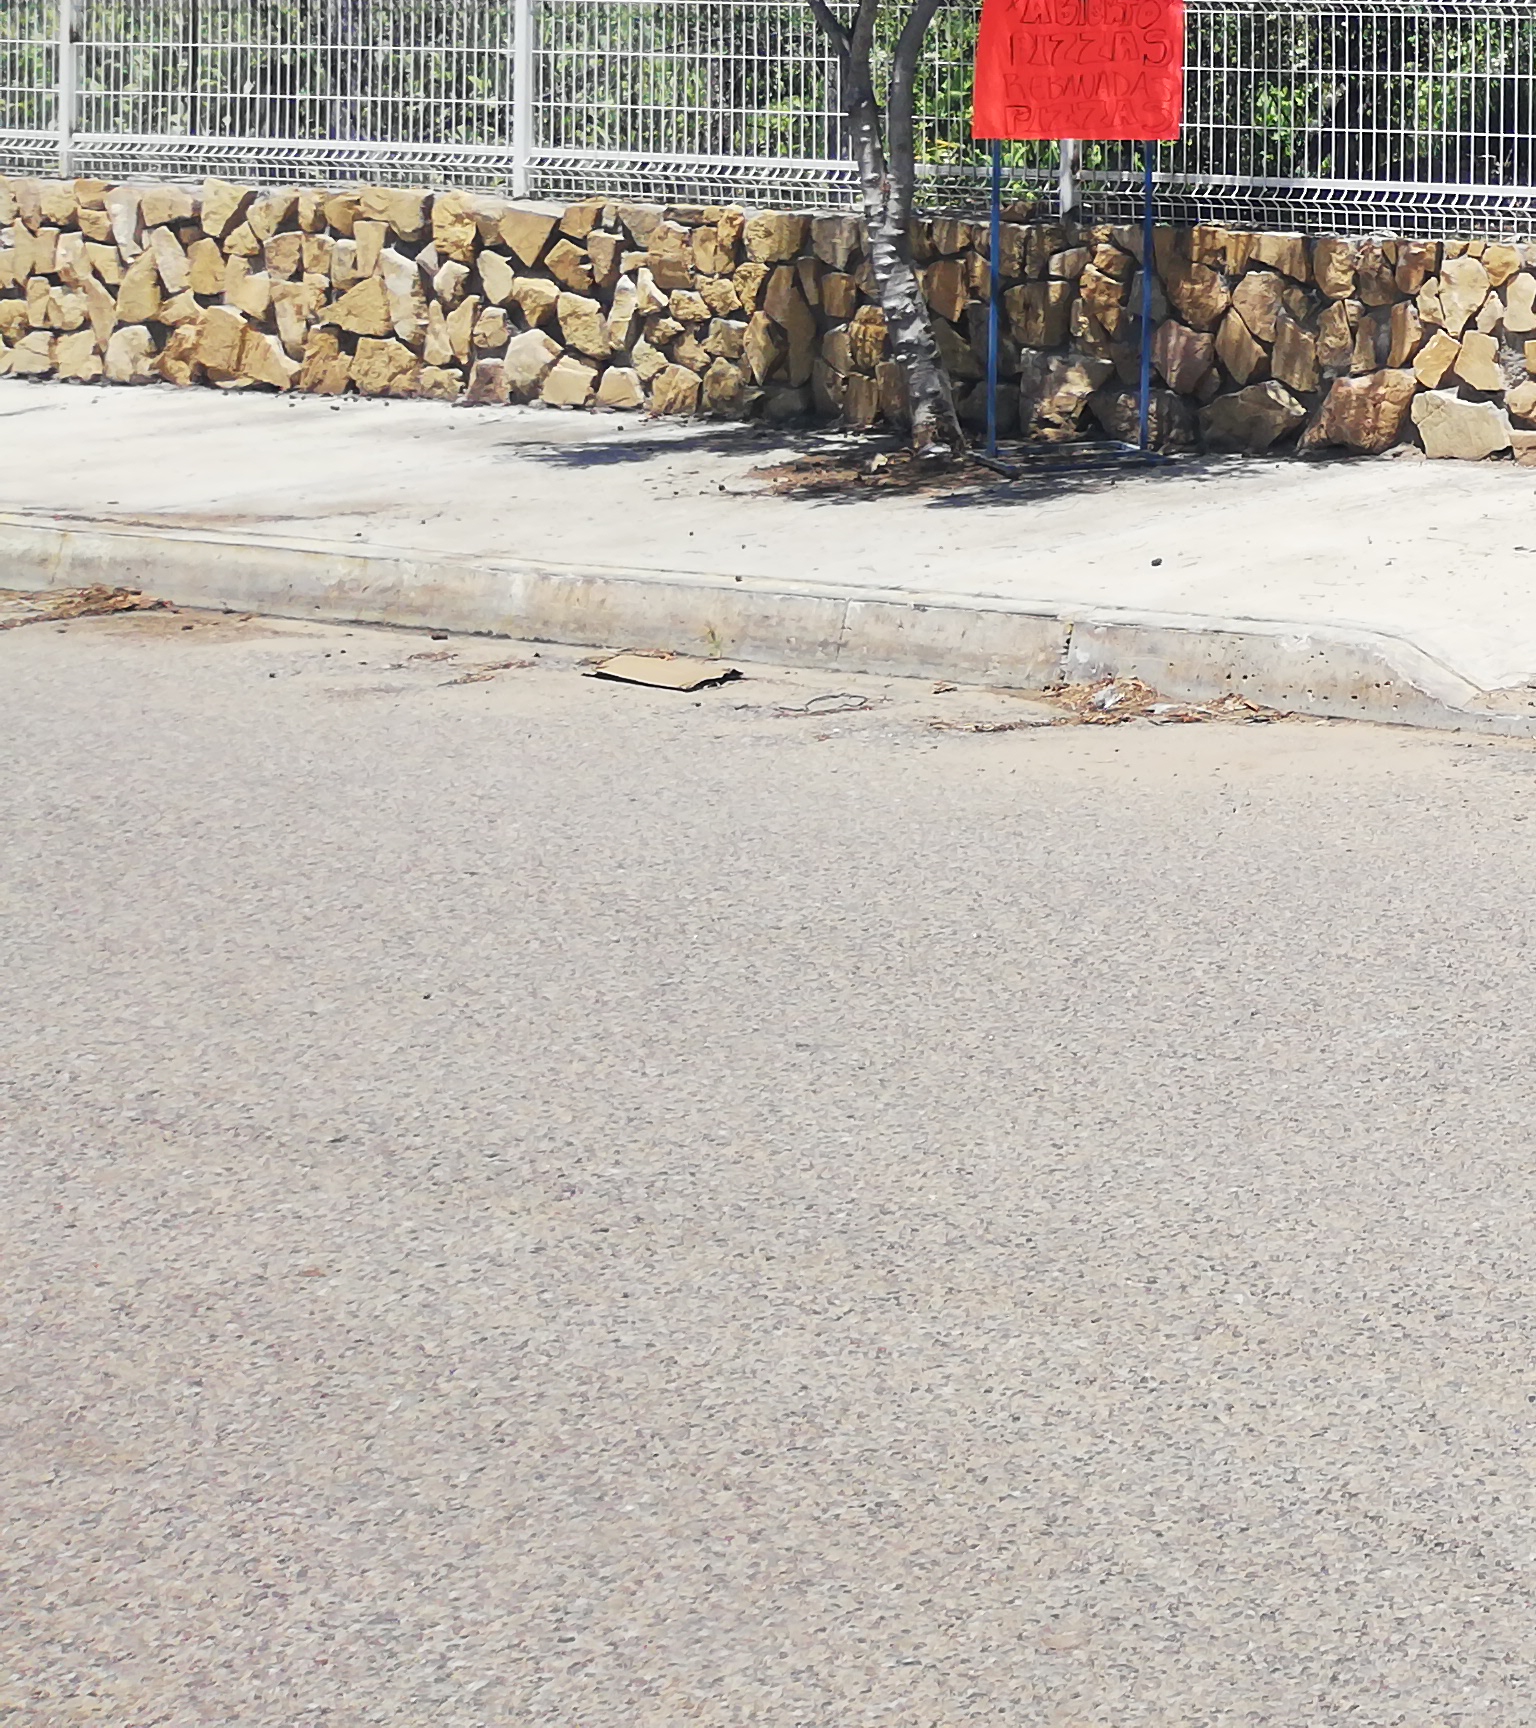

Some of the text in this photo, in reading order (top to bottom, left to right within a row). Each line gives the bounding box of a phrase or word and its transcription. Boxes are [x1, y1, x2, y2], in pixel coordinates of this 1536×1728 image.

[1010, 30, 1174, 66] PIZZAS
[1005, 72, 1178, 102] REBANADAS
[1005, 101, 1174, 135] PIZZAS
